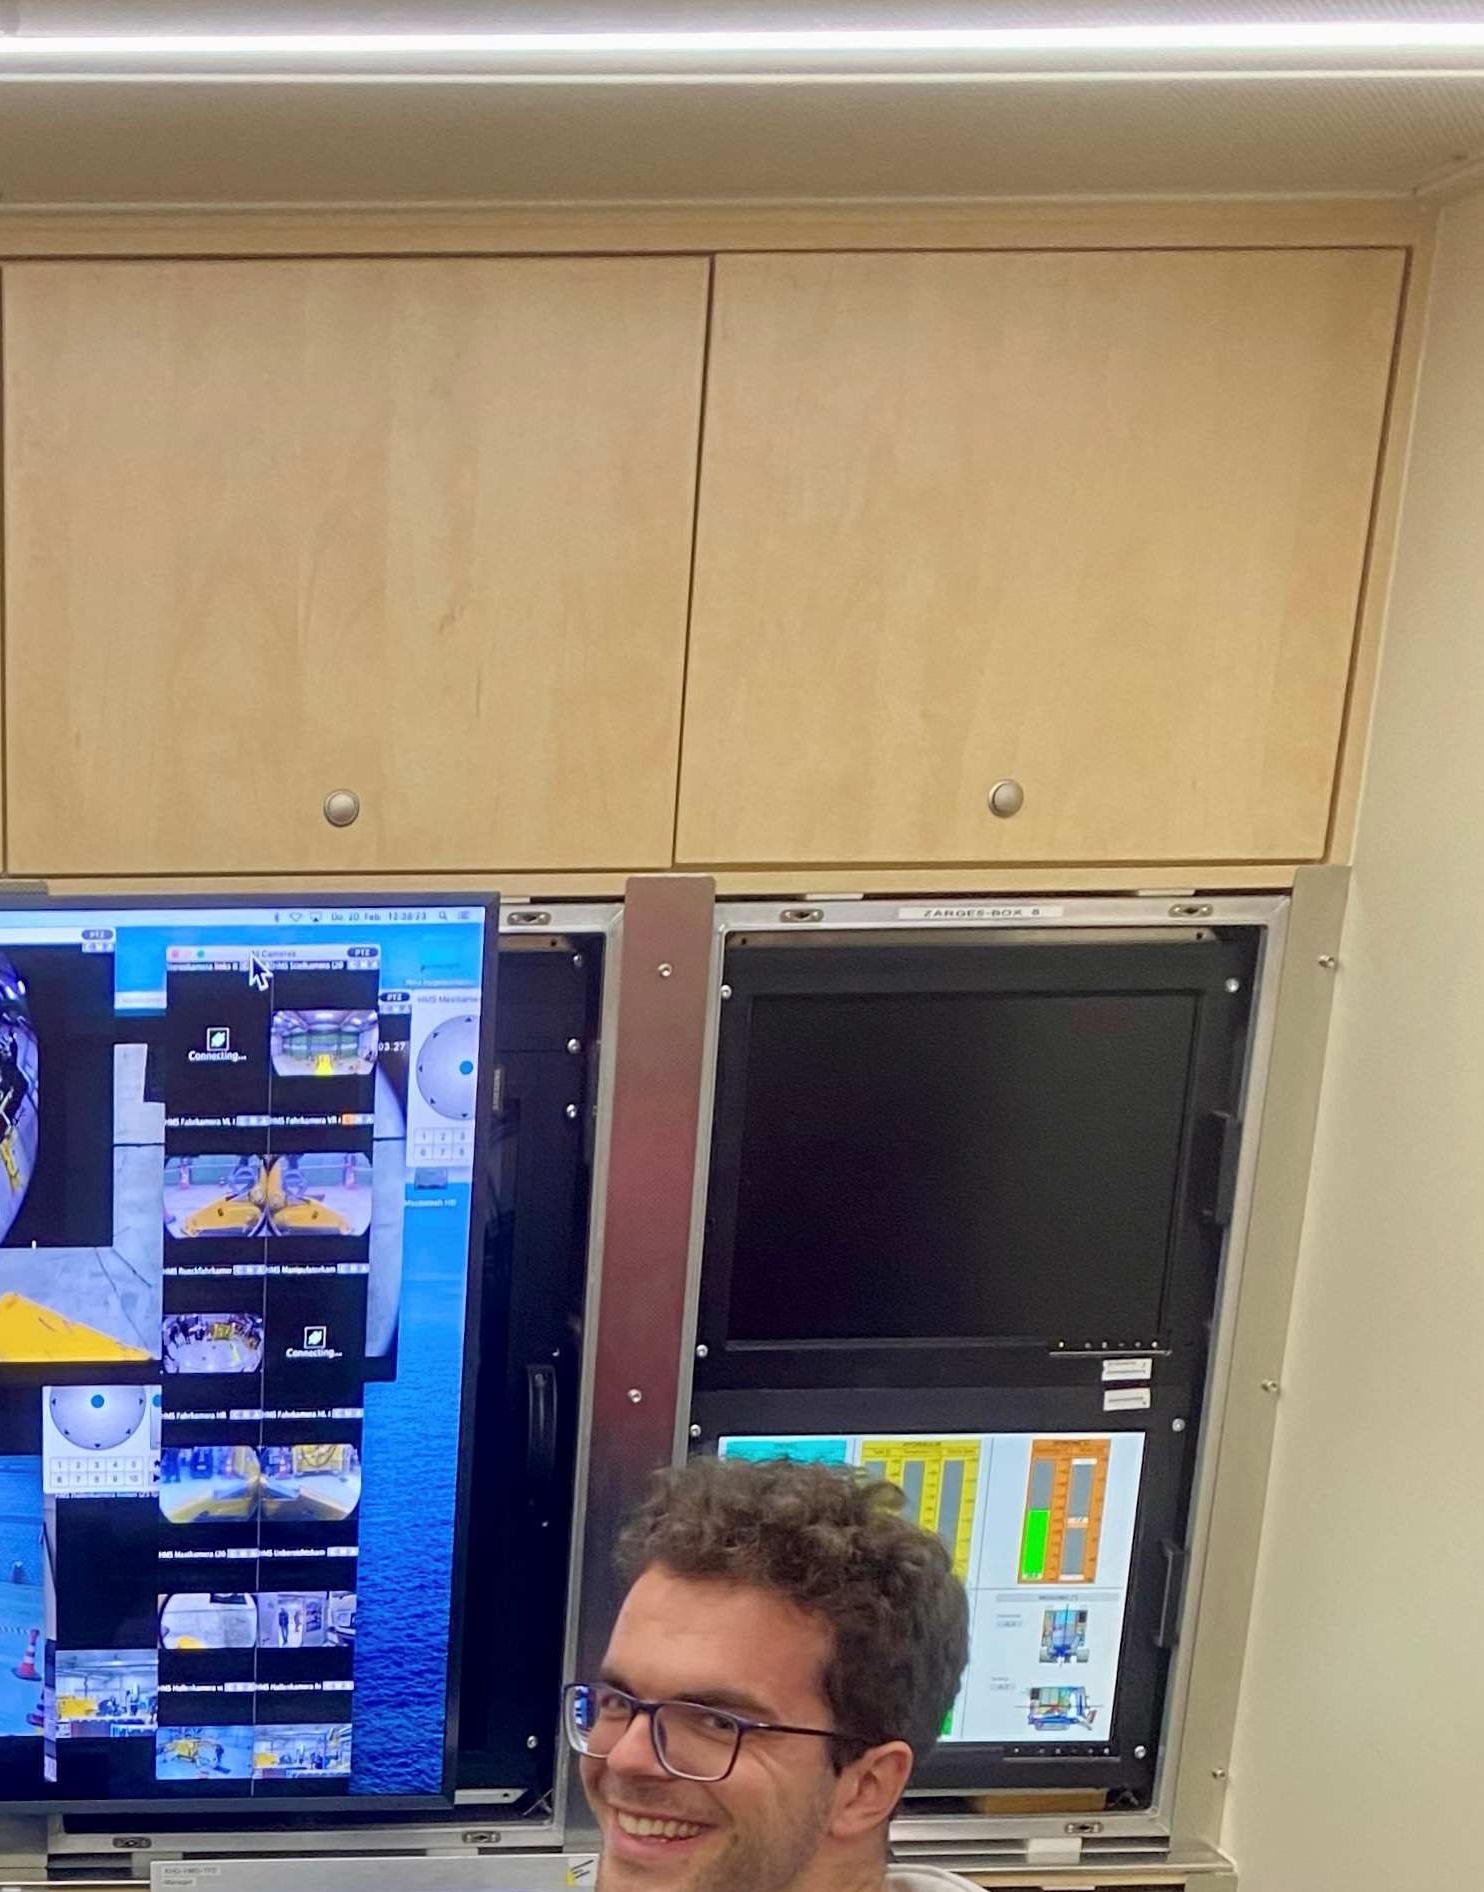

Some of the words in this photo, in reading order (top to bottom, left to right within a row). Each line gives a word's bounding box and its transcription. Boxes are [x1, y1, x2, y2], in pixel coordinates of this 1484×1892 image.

[924, 908, 1022, 917] ZARGES-BOX
[89, 931, 104, 939] PTZ
[354, 949, 370, 957] PTZ
[387, 993, 403, 1001] PTZ
[188, 1050, 247, 1061] Connecting...
[286, 1348, 342, 1359] Connecting...
